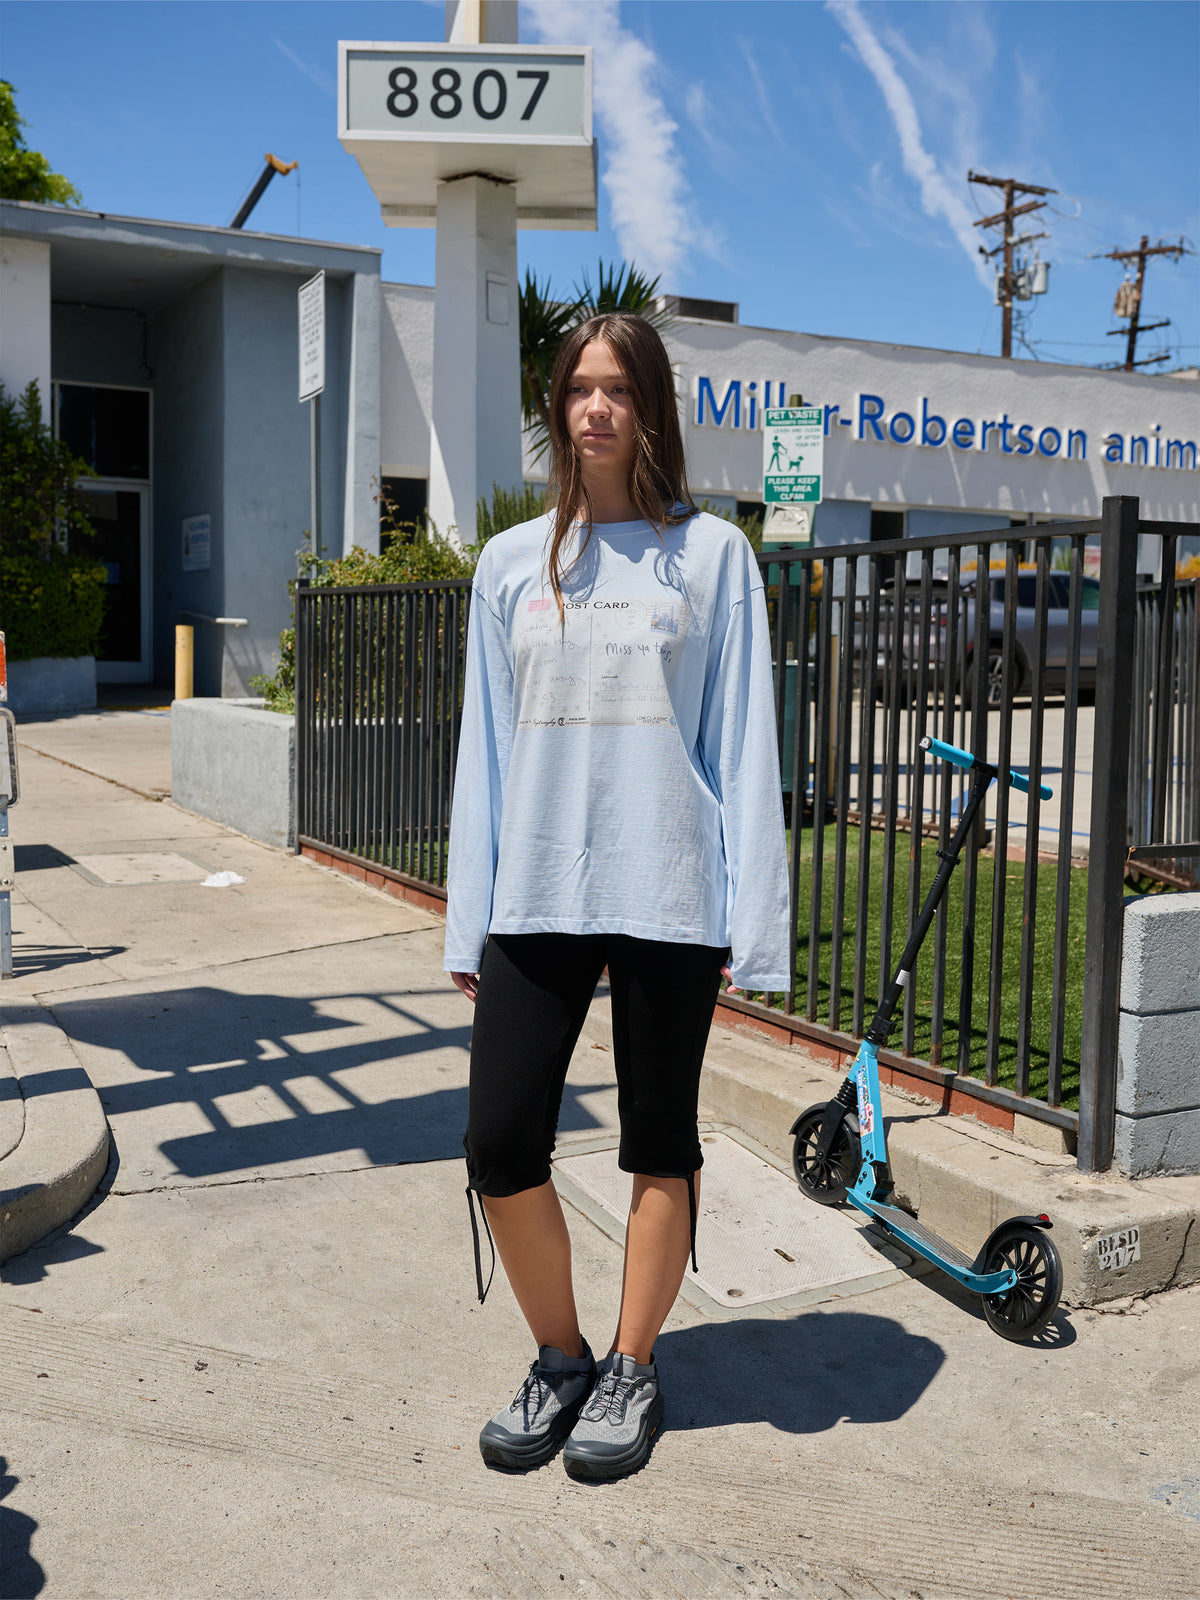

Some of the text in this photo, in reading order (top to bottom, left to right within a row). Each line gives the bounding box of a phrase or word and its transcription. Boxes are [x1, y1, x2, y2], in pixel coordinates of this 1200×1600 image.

[386, 66, 550, 121] 8807
[768, 410, 820, 420] PET WASTE
[695, 376, 1200, 470] Millr-Robertson anim
[773, 485, 790, 493] THIS
[593, 601, 630, 609] CARD
[605, 642, 632, 656] Miss
